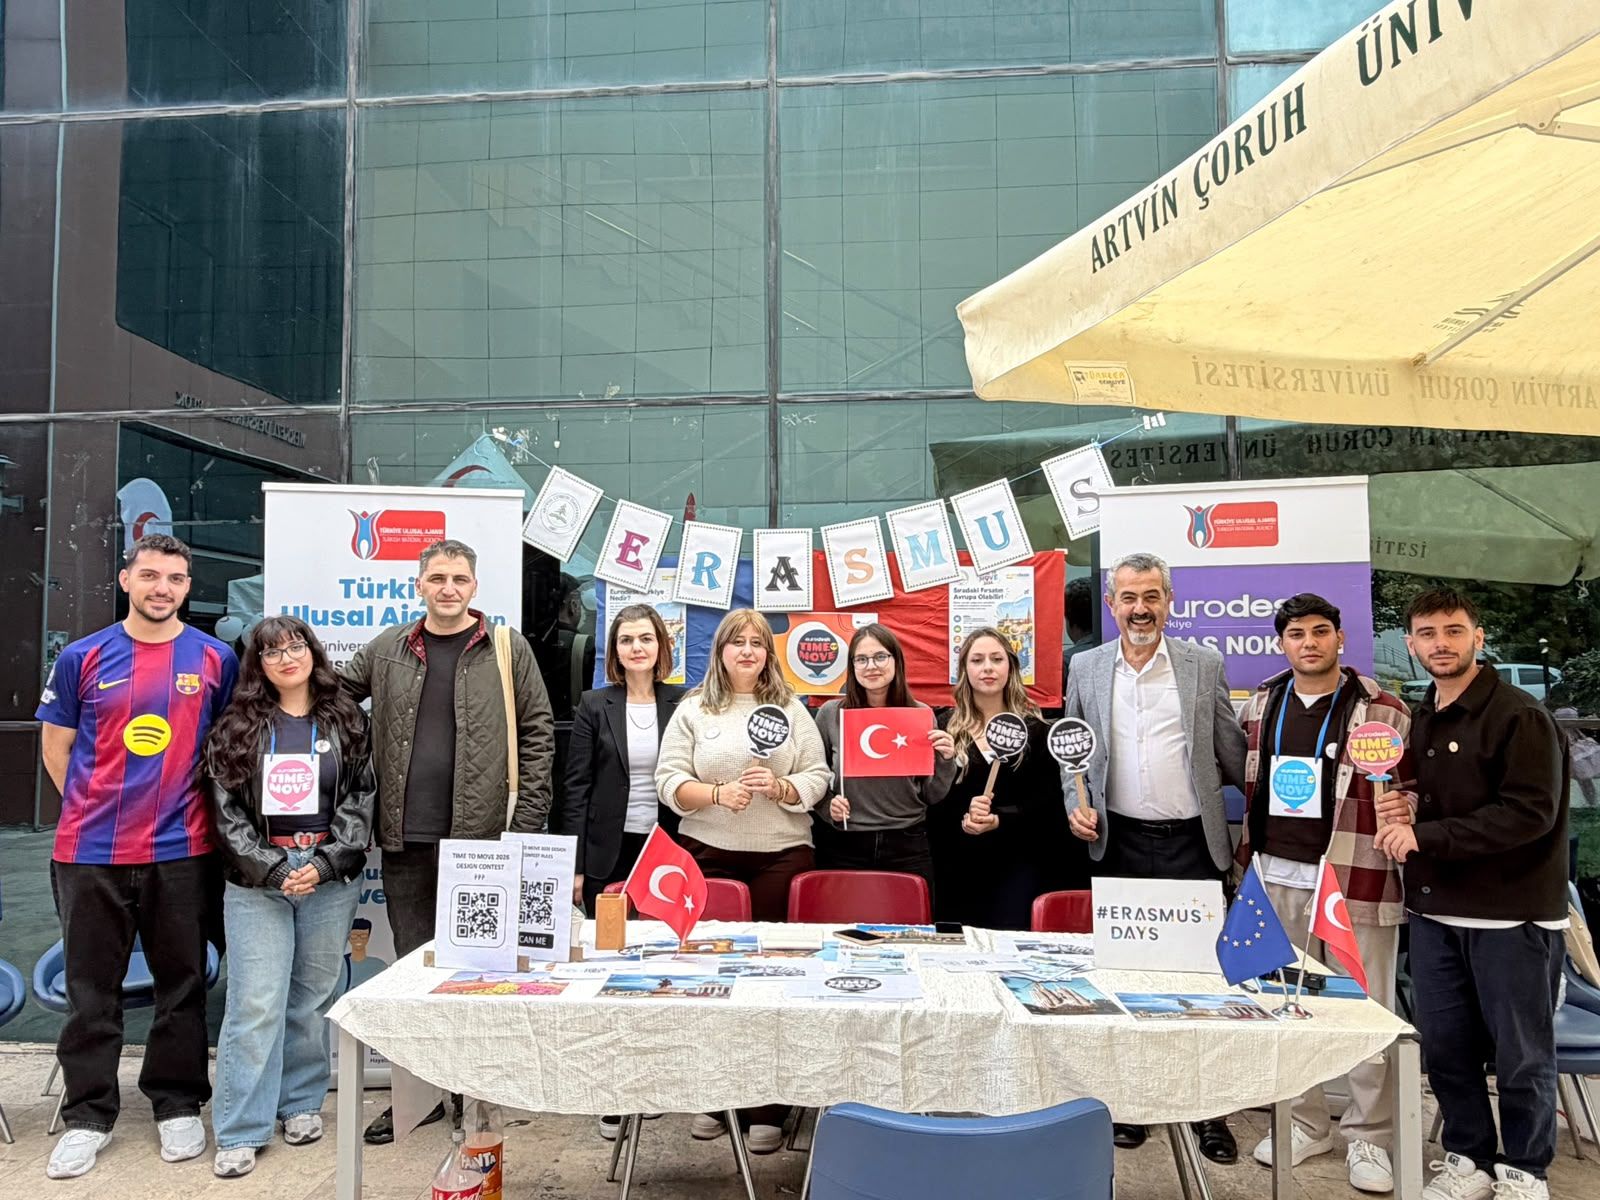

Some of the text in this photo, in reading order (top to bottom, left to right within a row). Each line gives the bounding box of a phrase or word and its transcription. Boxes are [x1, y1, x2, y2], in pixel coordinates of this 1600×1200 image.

[1092, 178, 1178, 274] ARTVİN
[1193, 82, 1307, 210] ÇORUH
[339, 577, 425, 606] Türki
[800, 642, 830, 652] TIME
[799, 651, 836, 662] MOVE
[752, 714, 783, 733] TIME
[990, 722, 1020, 738] TIME
[748, 721, 785, 742] MOVE
[986, 730, 1022, 747] MOVE
[1051, 732, 1084, 745] TIME
[1350, 737, 1392, 749] TIME
[1053, 739, 1091, 754] MOVE
[1351, 747, 1400, 762] MOVE
[270, 773, 305, 784] TIME
[1275, 774, 1307, 784] TIME
[270, 783, 311, 795] MOVE
[1274, 783, 1313, 795] MOVE
[1112, 926, 1159, 940] DAYS
[536, 937, 547, 945] ME
[1505, 1169, 1524, 1182] VANS
